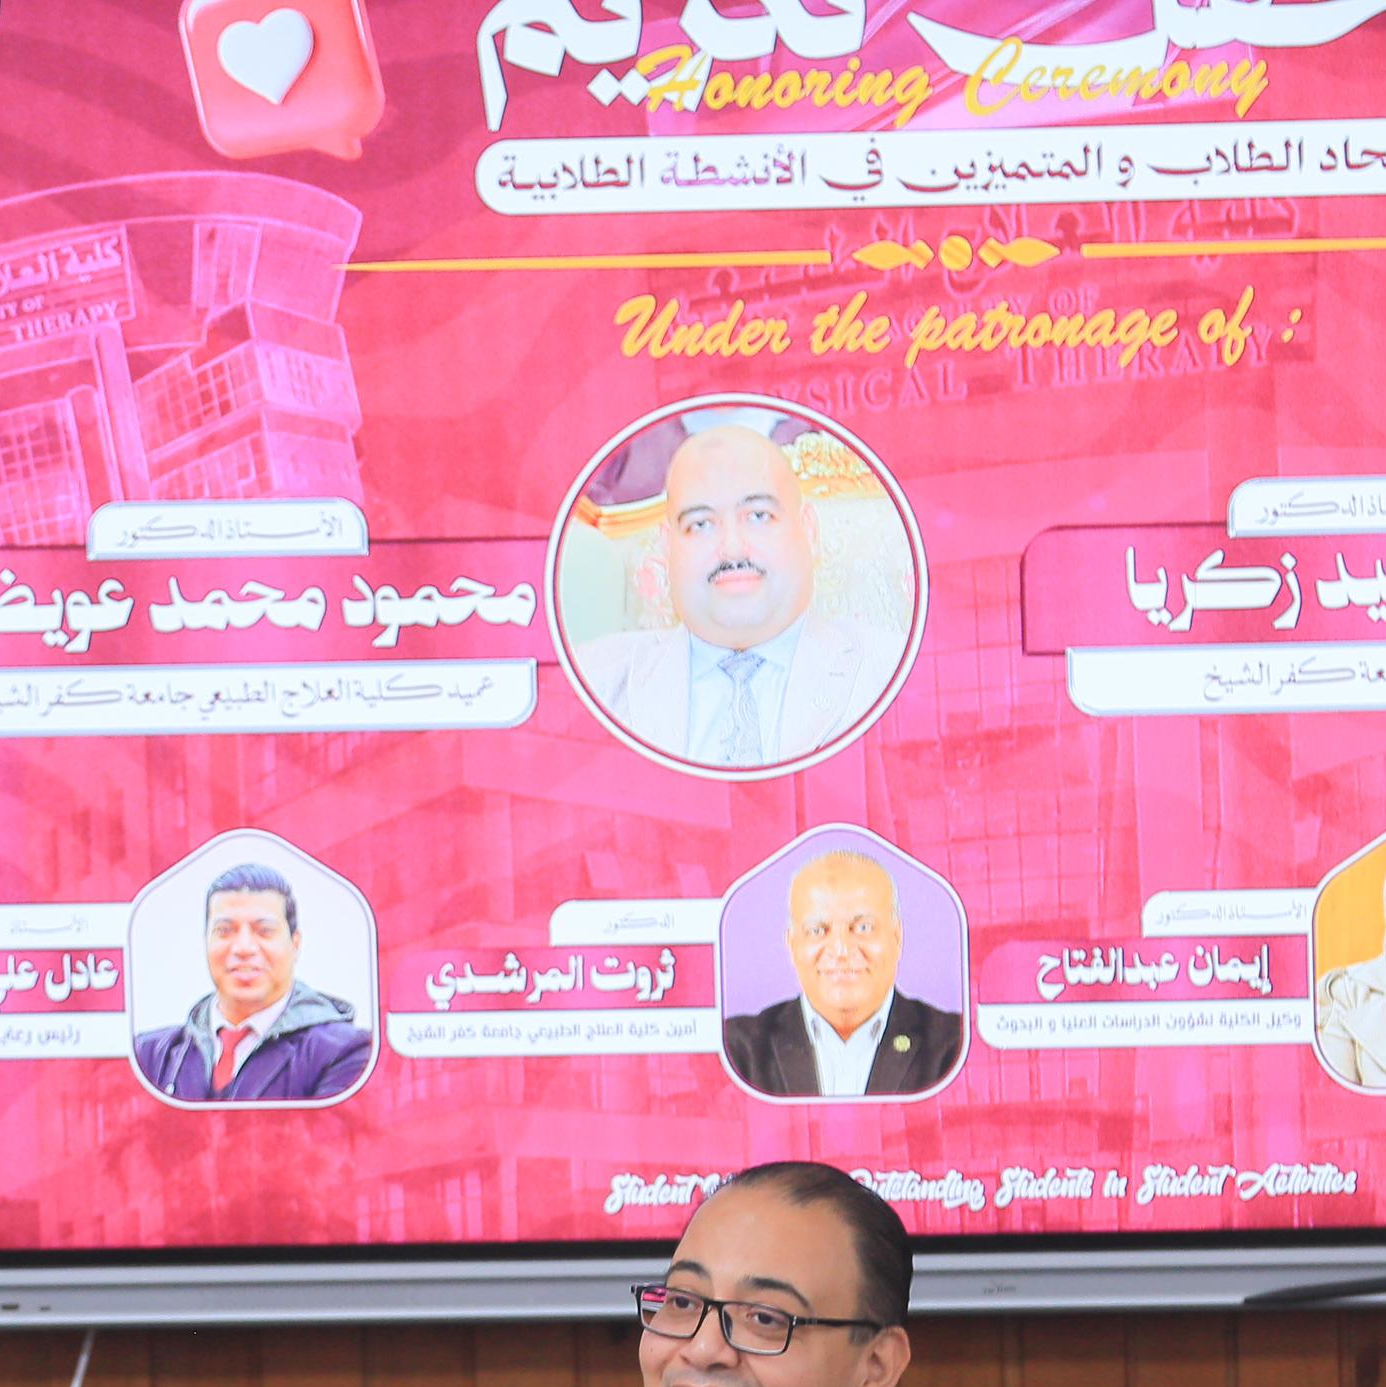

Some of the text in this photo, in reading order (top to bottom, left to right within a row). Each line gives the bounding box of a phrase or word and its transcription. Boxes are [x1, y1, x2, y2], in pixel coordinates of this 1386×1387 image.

[635, 43, 932, 129] Honoring
[963, 35, 1270, 119] Ceremony
[498, 152, 645, 201] الطلابية
[660, 143, 807, 187] الأنشطة
[819, 136, 885, 202] في
[895, 141, 1103, 193] المتميزين
[1117, 153, 1135, 188] و
[1148, 136, 1305, 187] الطلاب
[10, 301, 119, 343] THERAPY
[22, 295, 45, 312] OF
[612, 294, 790, 360] Under
[811, 291, 891, 353] the
[906, 297, 1179, 370] patronage
[1200, 287, 1255, 366] of
[148, 575, 327, 634] محمد
[343, 573, 538, 648] محمود
[1125, 545, 1303, 633] زكريا
[39, 679, 123, 717] كفر
[126, 682, 193, 711] جامعة
[200, 678, 276, 720] الطبيعي
[281, 678, 351, 718] العلاج
[355, 673, 443, 709] كلية
[448, 676, 495, 707] عميد
[1203, 660, 1270, 702] الشيخ
[1271, 656, 1356, 696] كفر
[44, 953, 119, 1002] عادل
[426, 948, 676, 1011] ثروت المرشدي
[1188, 943, 1273, 996] إيمان
[604, 1172, 696, 1214] Student
[994, 1166, 1095, 1210] Students
[1137, 1163, 1235, 1205] Student
[1236, 1163, 1357, 1200] Activities
